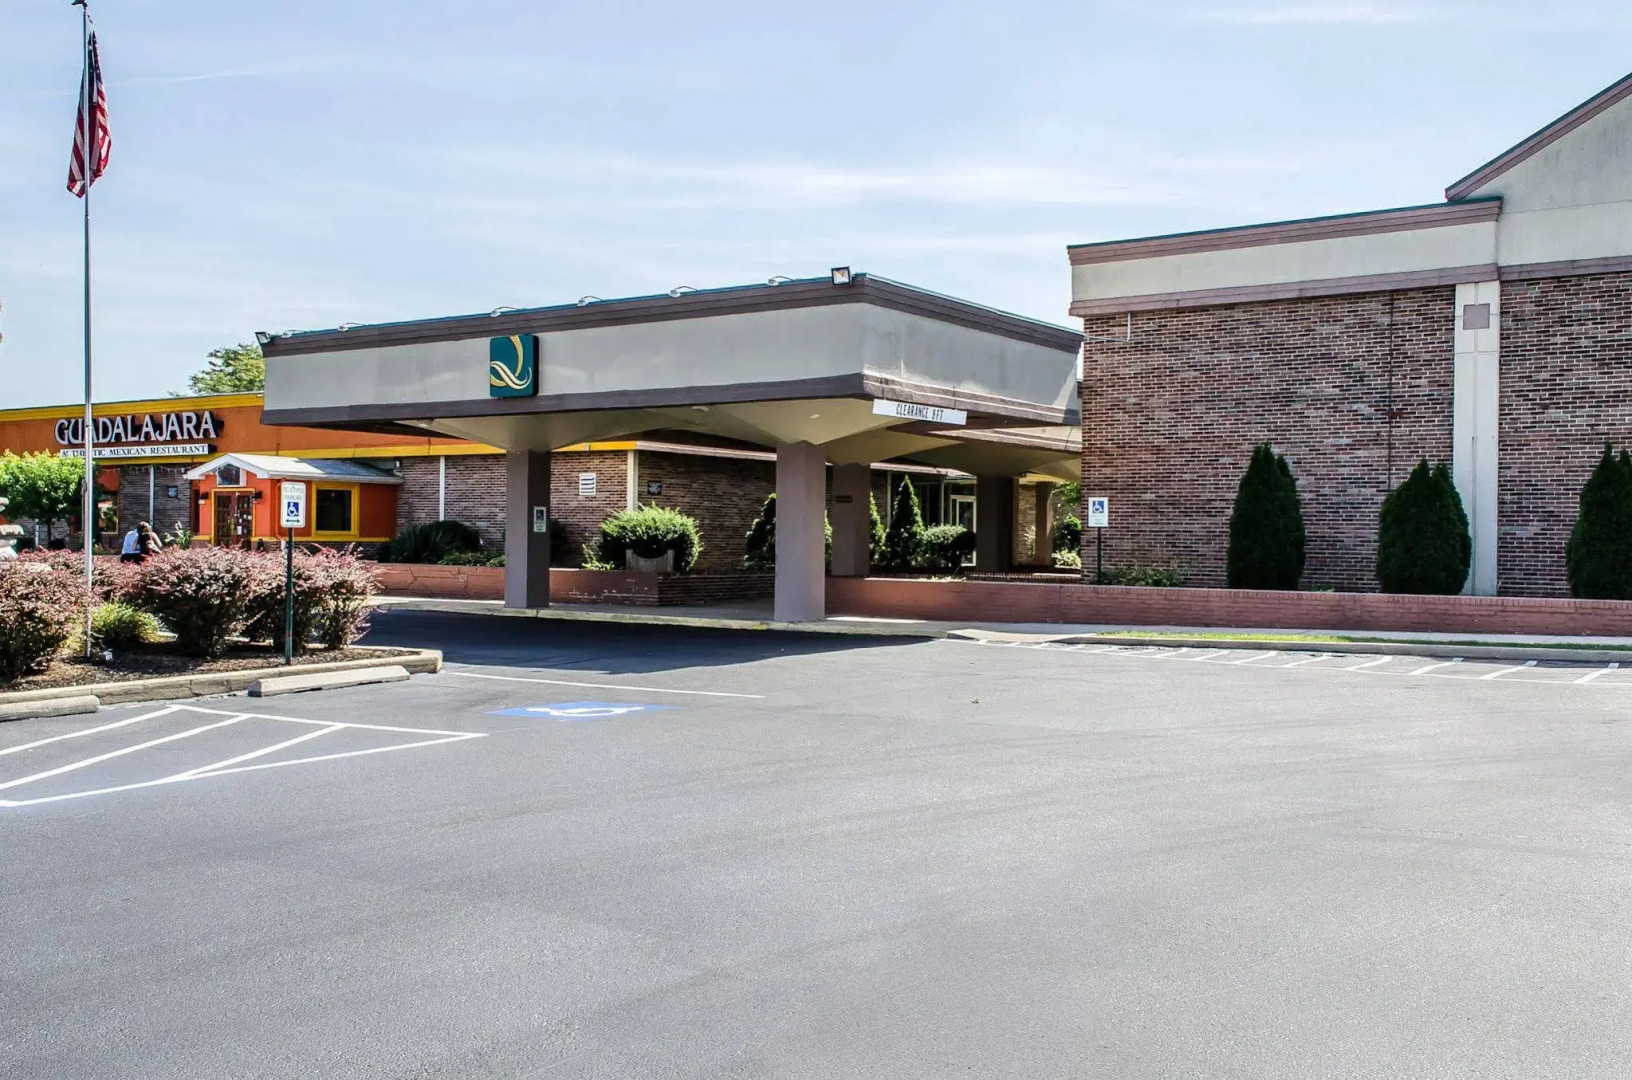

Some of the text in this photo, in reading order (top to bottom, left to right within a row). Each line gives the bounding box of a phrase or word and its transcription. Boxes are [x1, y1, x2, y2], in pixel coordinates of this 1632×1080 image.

[895, 403, 944, 421] CLEARANCE 9FT
[61, 445, 207, 458] ATHETIC MEXICAN RESTAURANT
